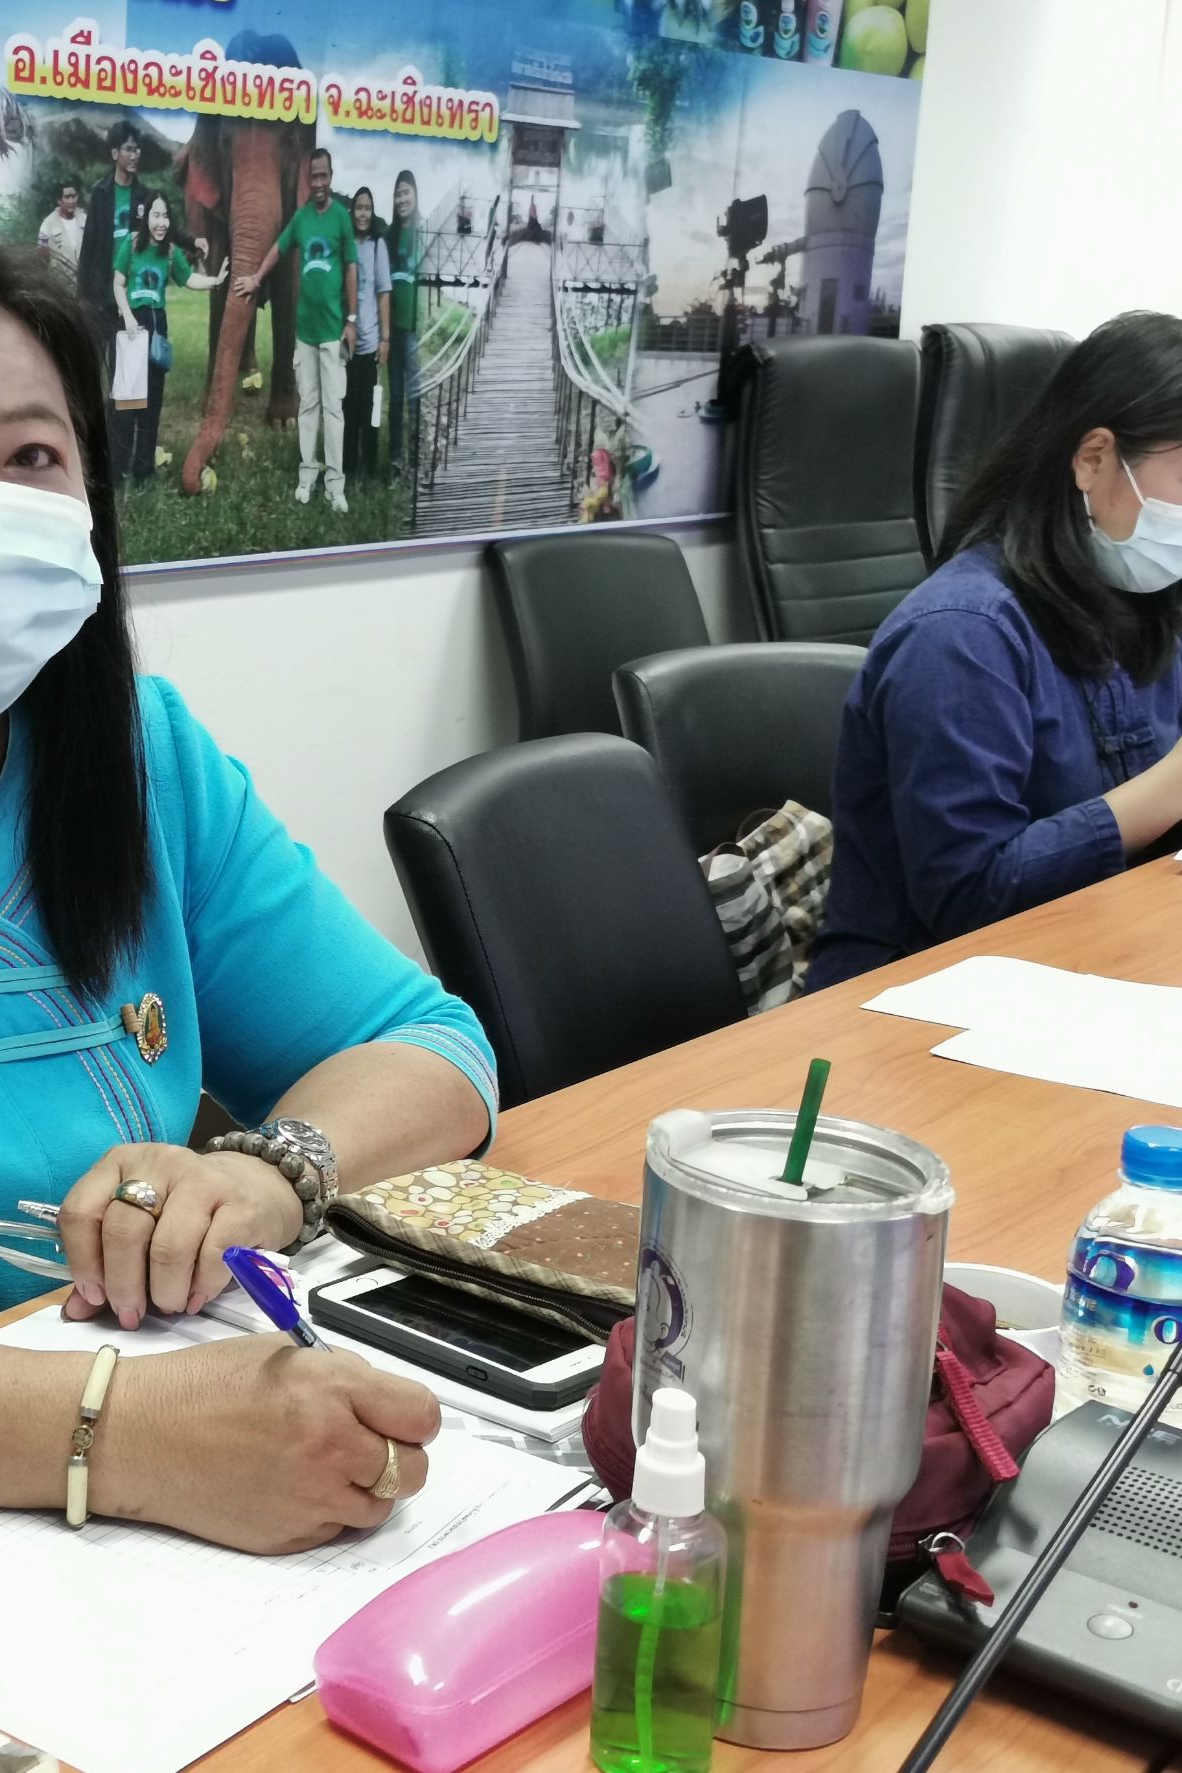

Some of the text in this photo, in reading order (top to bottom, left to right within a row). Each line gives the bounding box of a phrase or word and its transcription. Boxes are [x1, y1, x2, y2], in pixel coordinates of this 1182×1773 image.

[11, 30, 312, 114] อ.เมืองฉะเชิงเทรา
[324, 76, 495, 134] จ.ฉะเชิงเทรา
